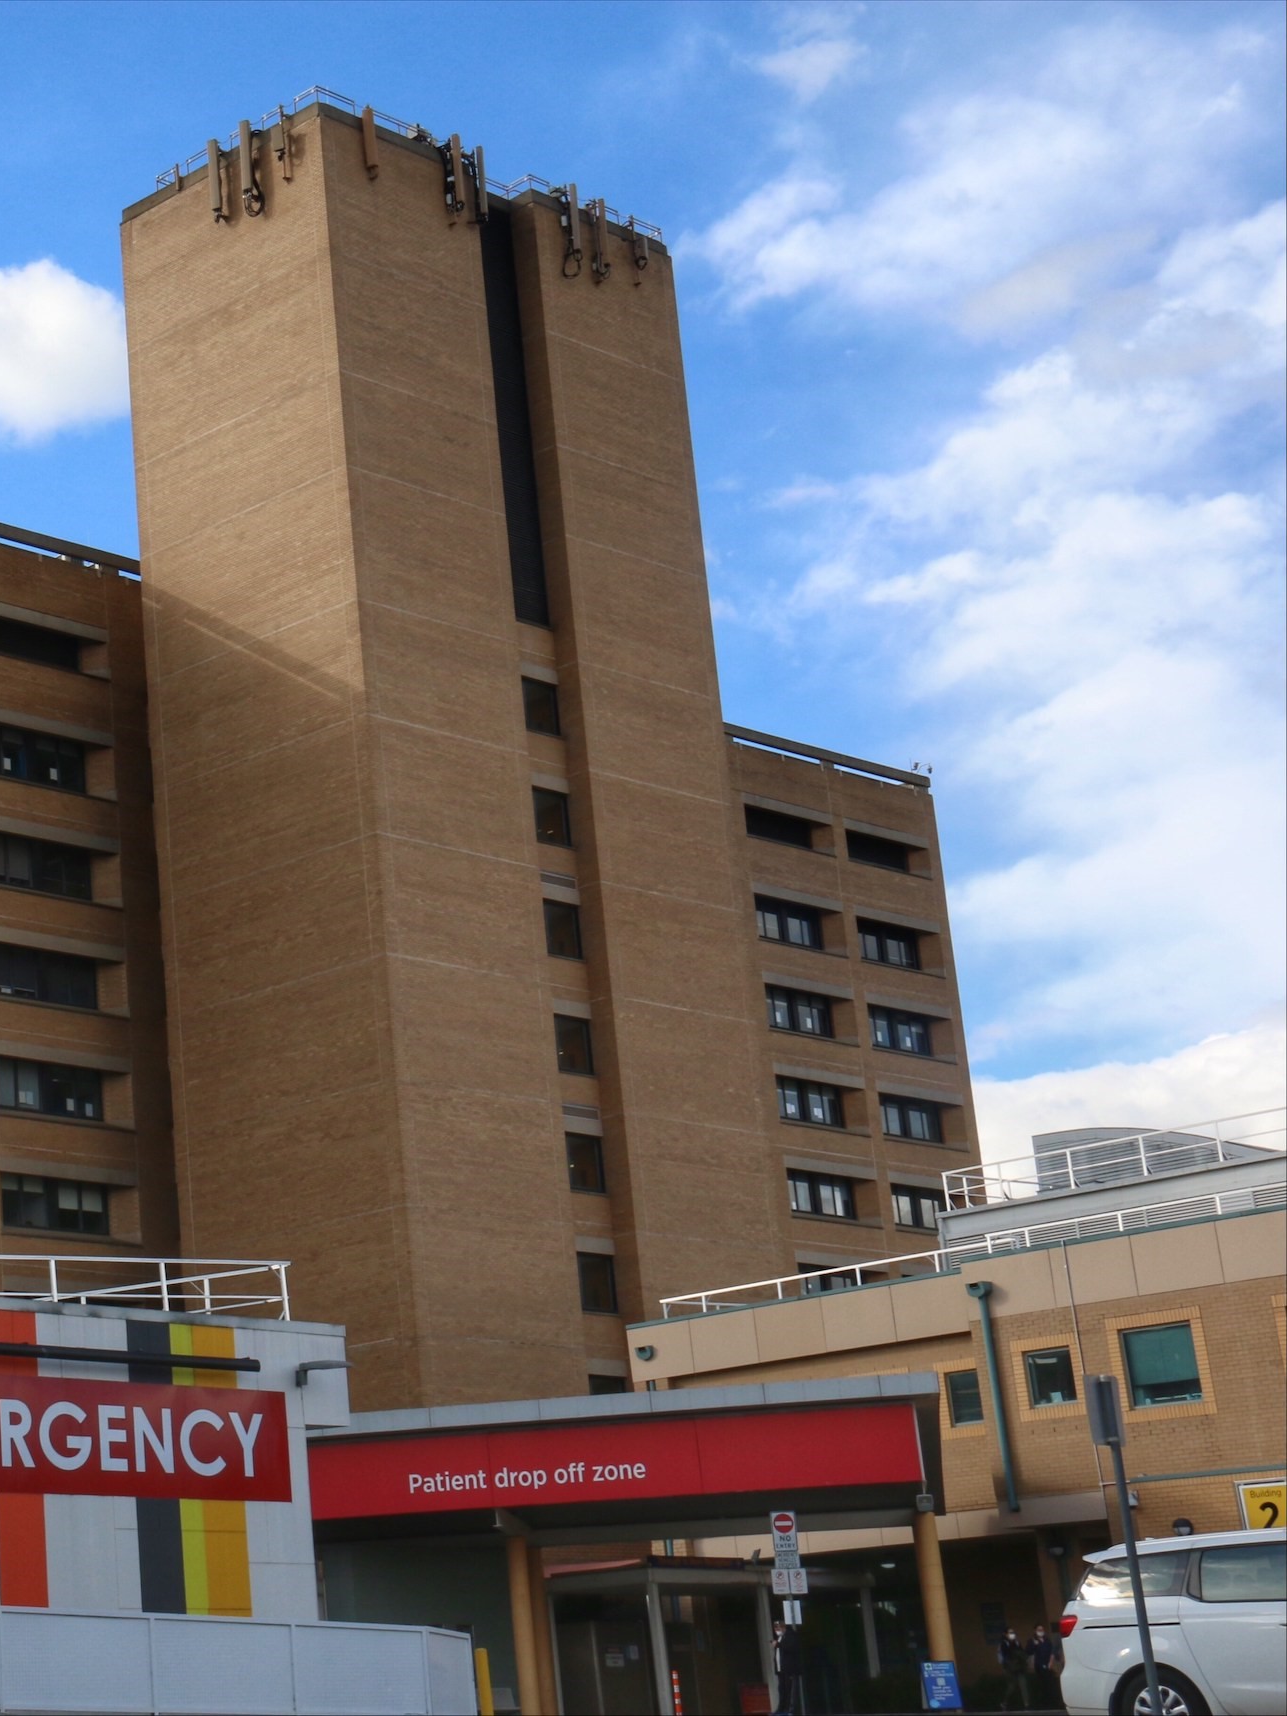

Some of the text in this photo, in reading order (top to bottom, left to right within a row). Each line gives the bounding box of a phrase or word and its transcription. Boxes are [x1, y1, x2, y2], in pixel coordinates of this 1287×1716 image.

[408, 1461, 647, 1494] Patient drop off zone
[1249, 1490, 1281, 1499] Building
[1259, 1501, 1279, 1528] 2
